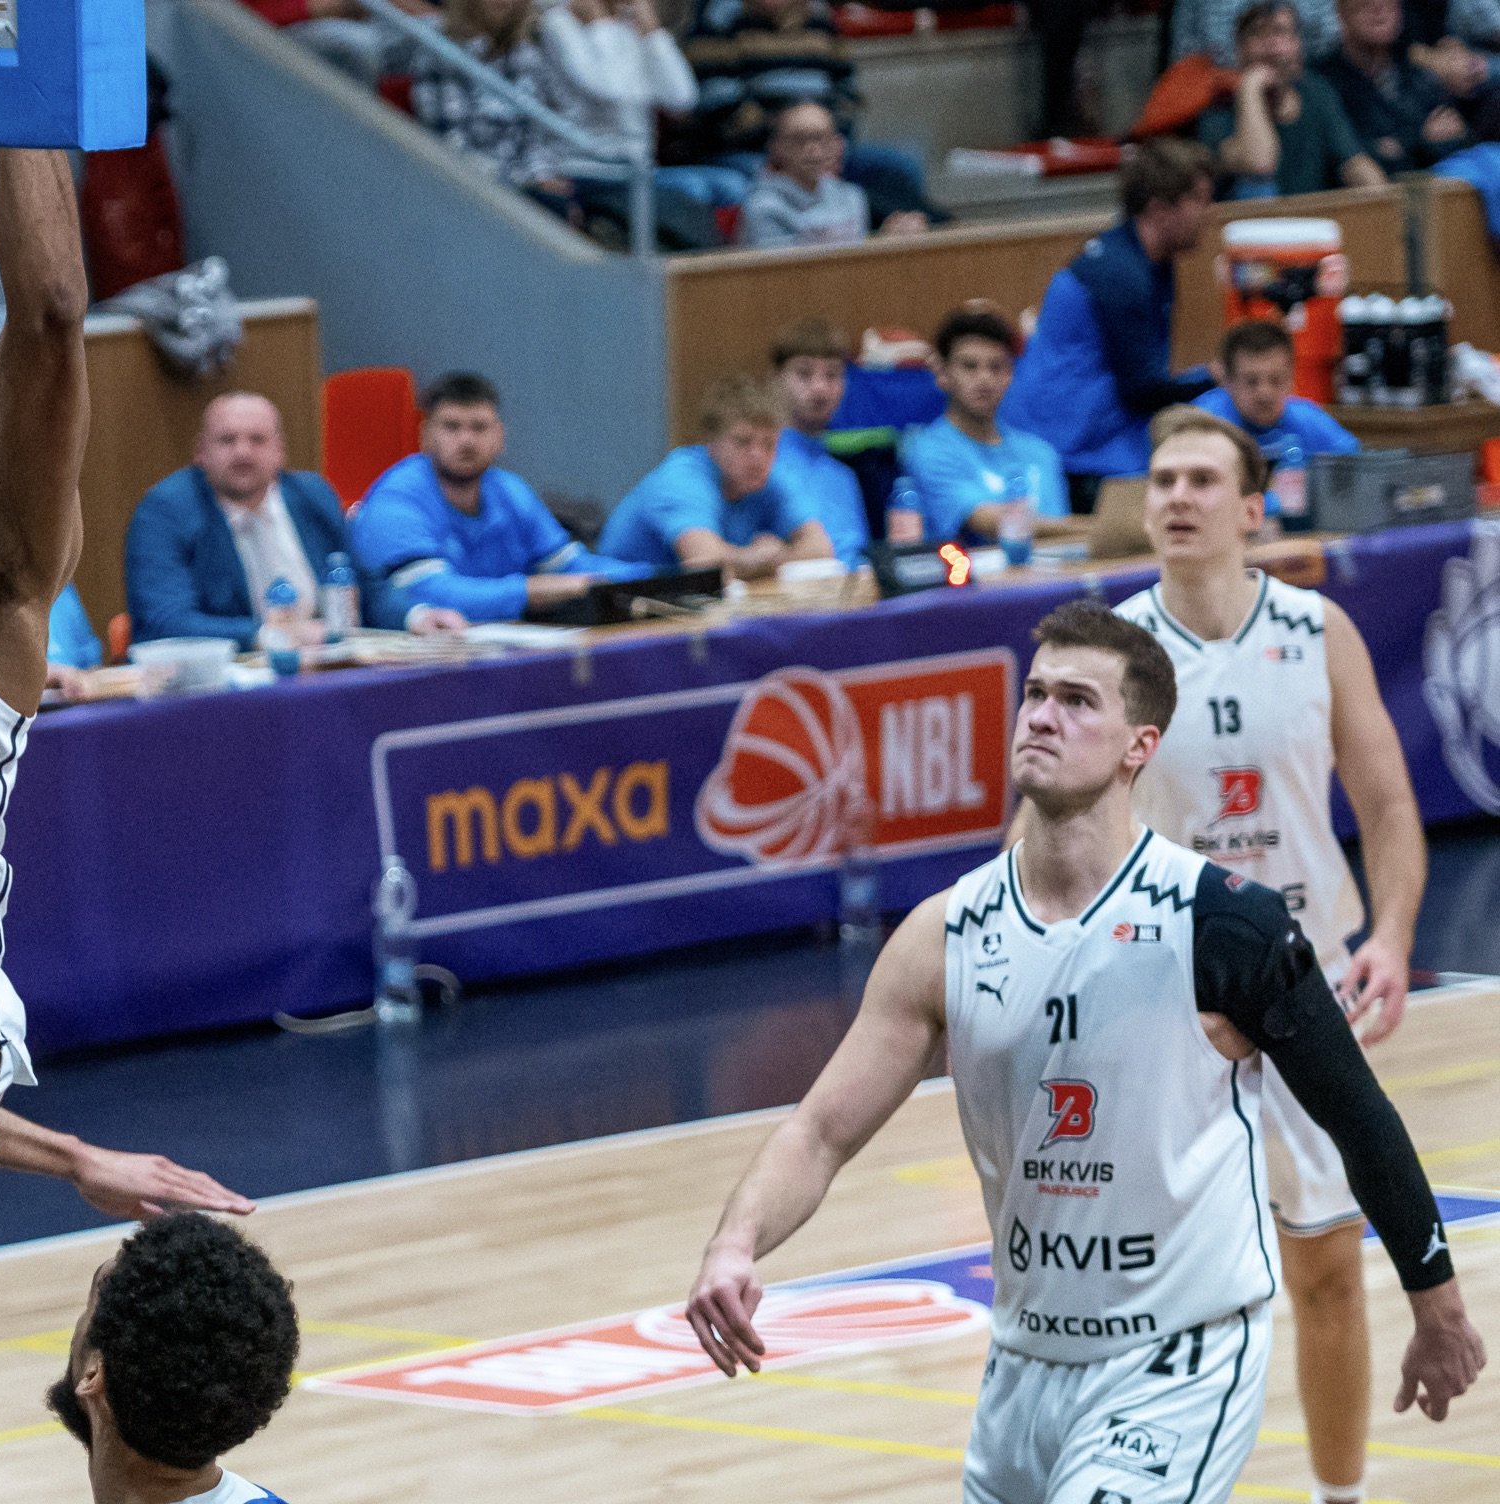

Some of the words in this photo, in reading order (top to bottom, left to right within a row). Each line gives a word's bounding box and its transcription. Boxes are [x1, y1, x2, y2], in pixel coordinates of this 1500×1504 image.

[1208, 696, 1242, 735] 13
[880, 691, 985, 819] NBL
[425, 760, 671, 871] maxa
[1045, 993, 1078, 1045] 21
[1023, 1159, 1054, 1180] BK
[1060, 1161, 1115, 1182] KVIS
[1040, 1231, 1156, 1272] KVIS
[1144, 1322, 1207, 1377] 21
[1110, 1431, 1161, 1461] HAK
